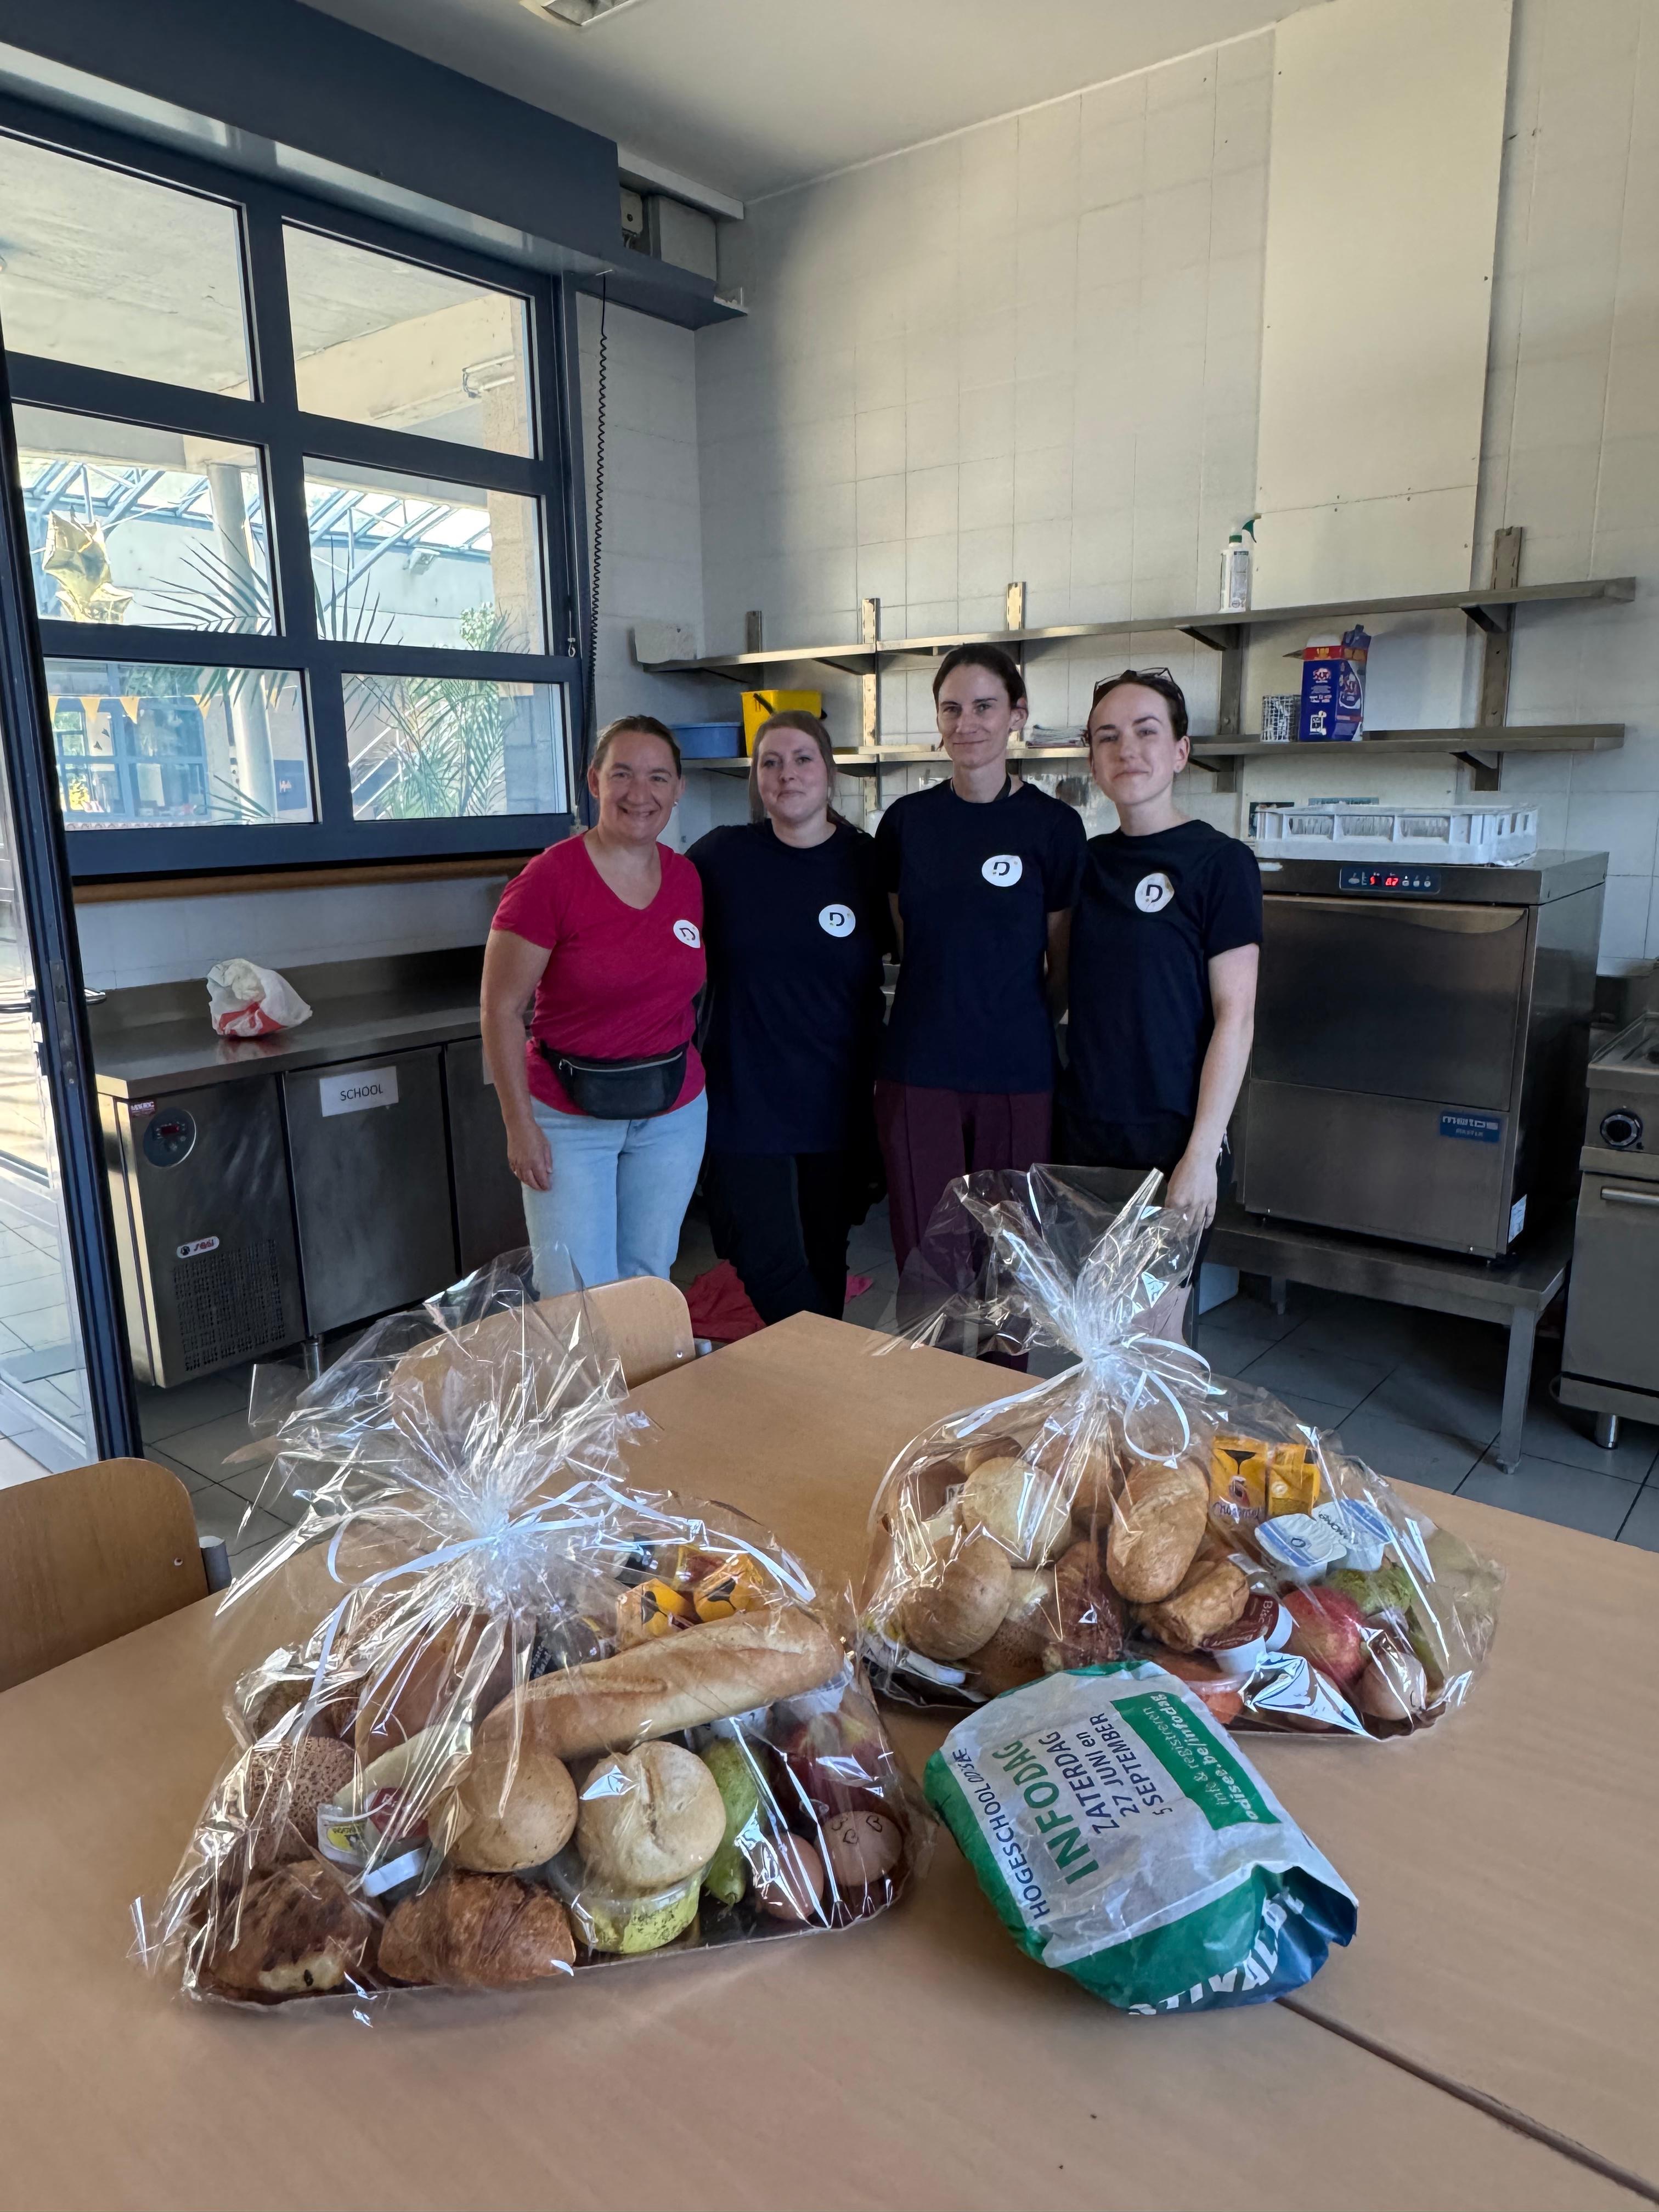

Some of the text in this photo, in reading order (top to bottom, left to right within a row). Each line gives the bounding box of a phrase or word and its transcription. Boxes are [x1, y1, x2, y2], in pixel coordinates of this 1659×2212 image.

[340, 1084, 383, 1101] SCHOOL
[1038, 1731, 1120, 1835] ZATERDAG
[1075, 1731, 1140, 1818] 27 JUNI en
[1090, 1712, 1164, 1807] SEPTEMBER
[1143, 1707, 1199, 1769] registreren
[1150, 1694, 1259, 1820] odisee.be/infodag
[1193, 1770, 1208, 1782] &
[974, 1783, 1050, 1920] HOGESCHOOL
[991, 1740, 1099, 1884] INFODAG
